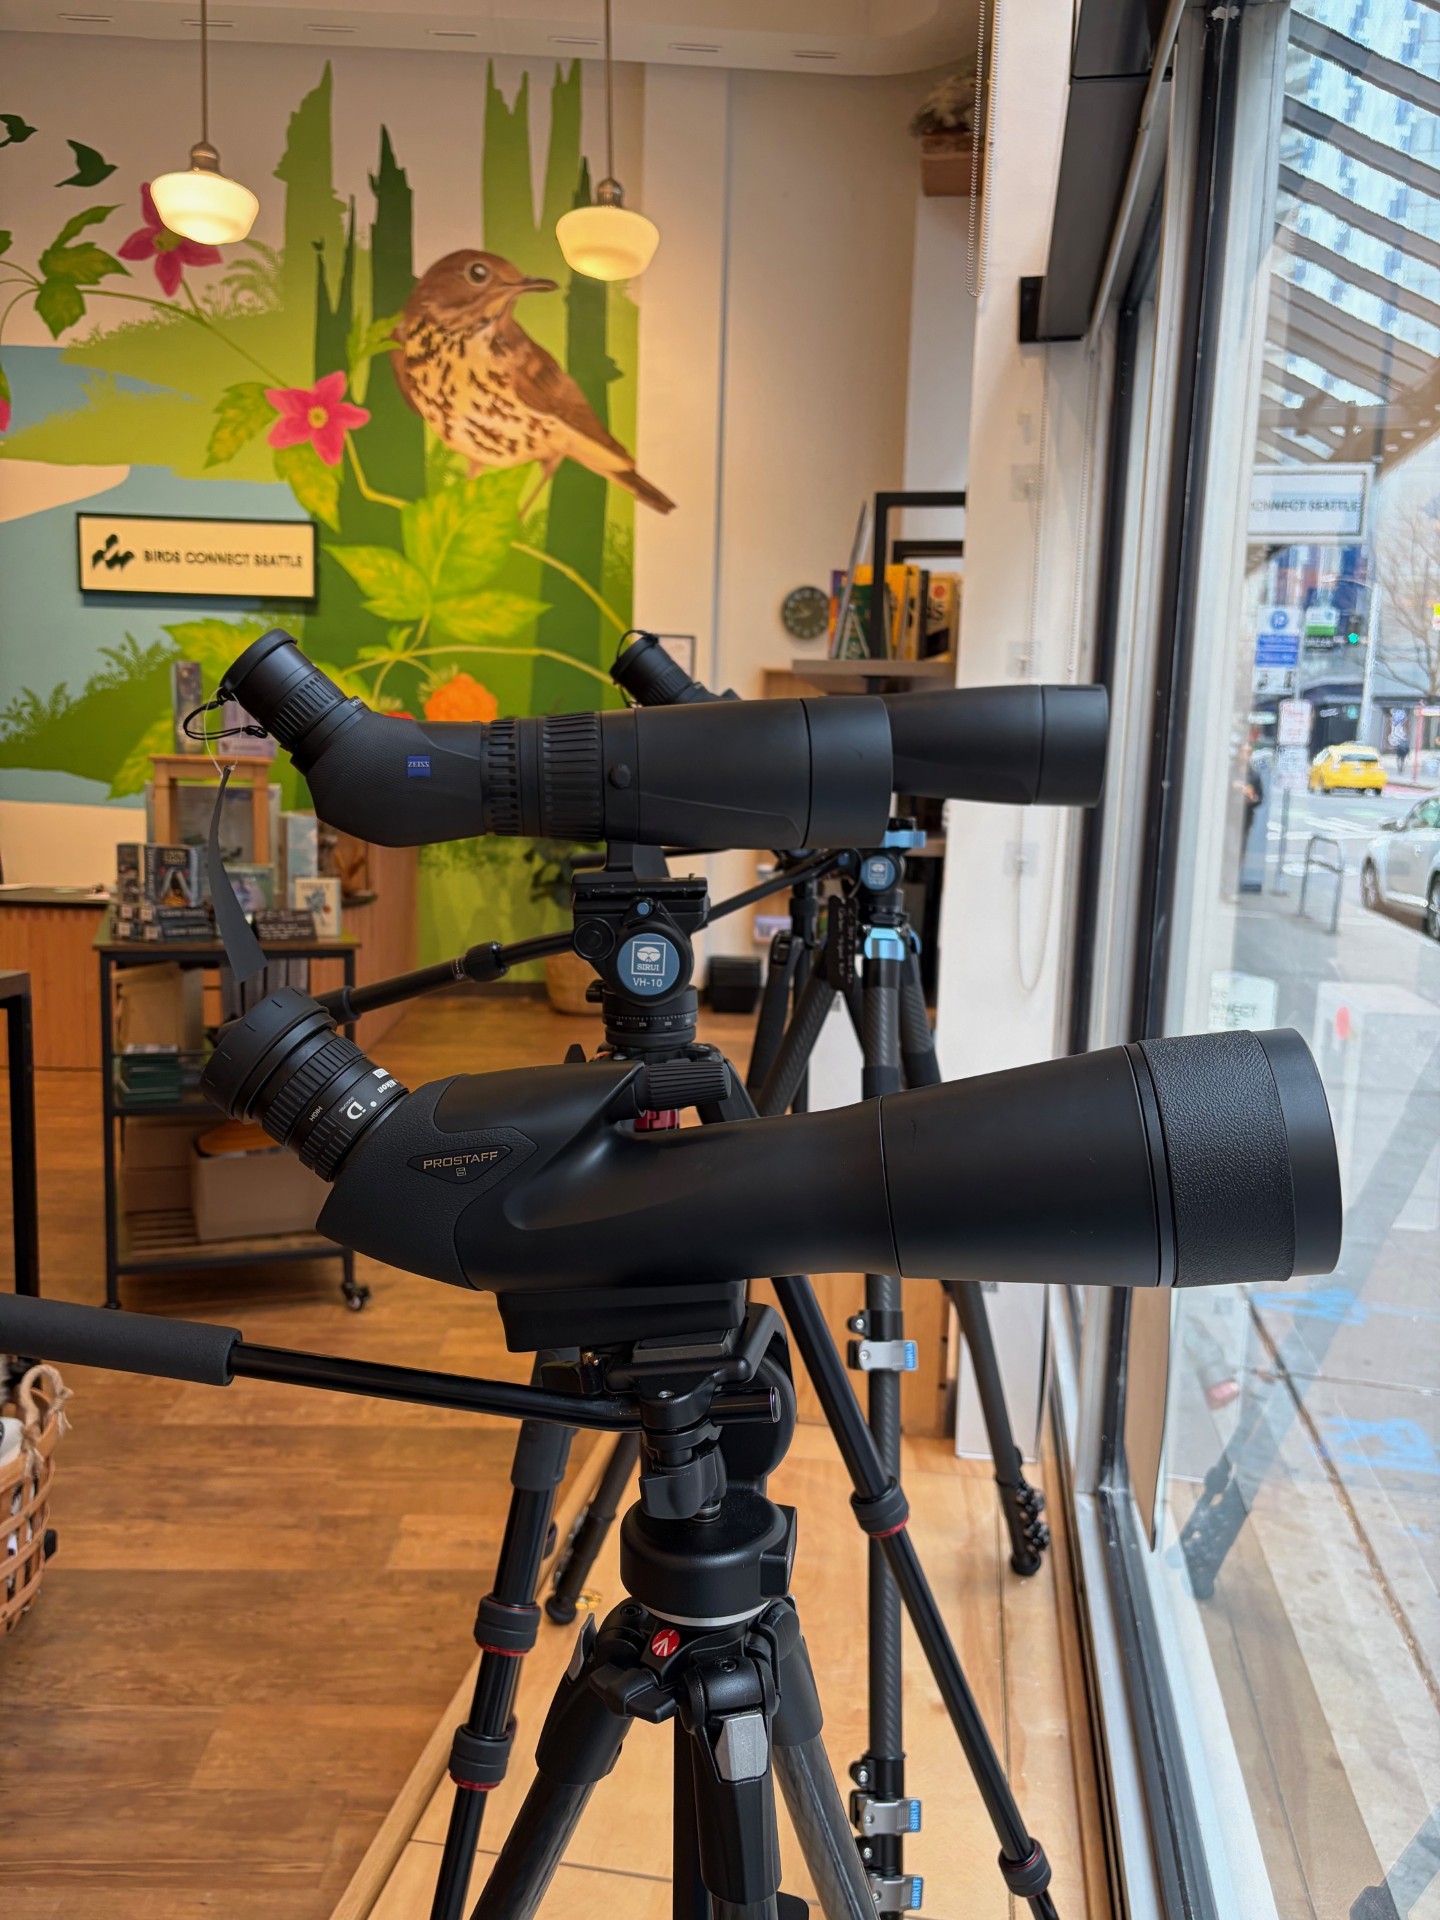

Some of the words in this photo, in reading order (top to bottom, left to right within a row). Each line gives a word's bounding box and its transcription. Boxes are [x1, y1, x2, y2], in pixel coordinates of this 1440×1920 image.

[144, 550, 181, 564] BIRDS
[185, 551, 250, 566] CONNECT
[254, 554, 303, 568] SEATTLE
[637, 963, 659, 971] SIRUI
[633, 978, 662, 987] VH-10
[376, 1079, 400, 1094] Nikon
[309, 1105, 323, 1123] HIGH
[423, 1151, 498, 1169] PROSTAFF
[911, 1801, 920, 1830] SIRUI
[912, 1878, 922, 1909] SIRUI
